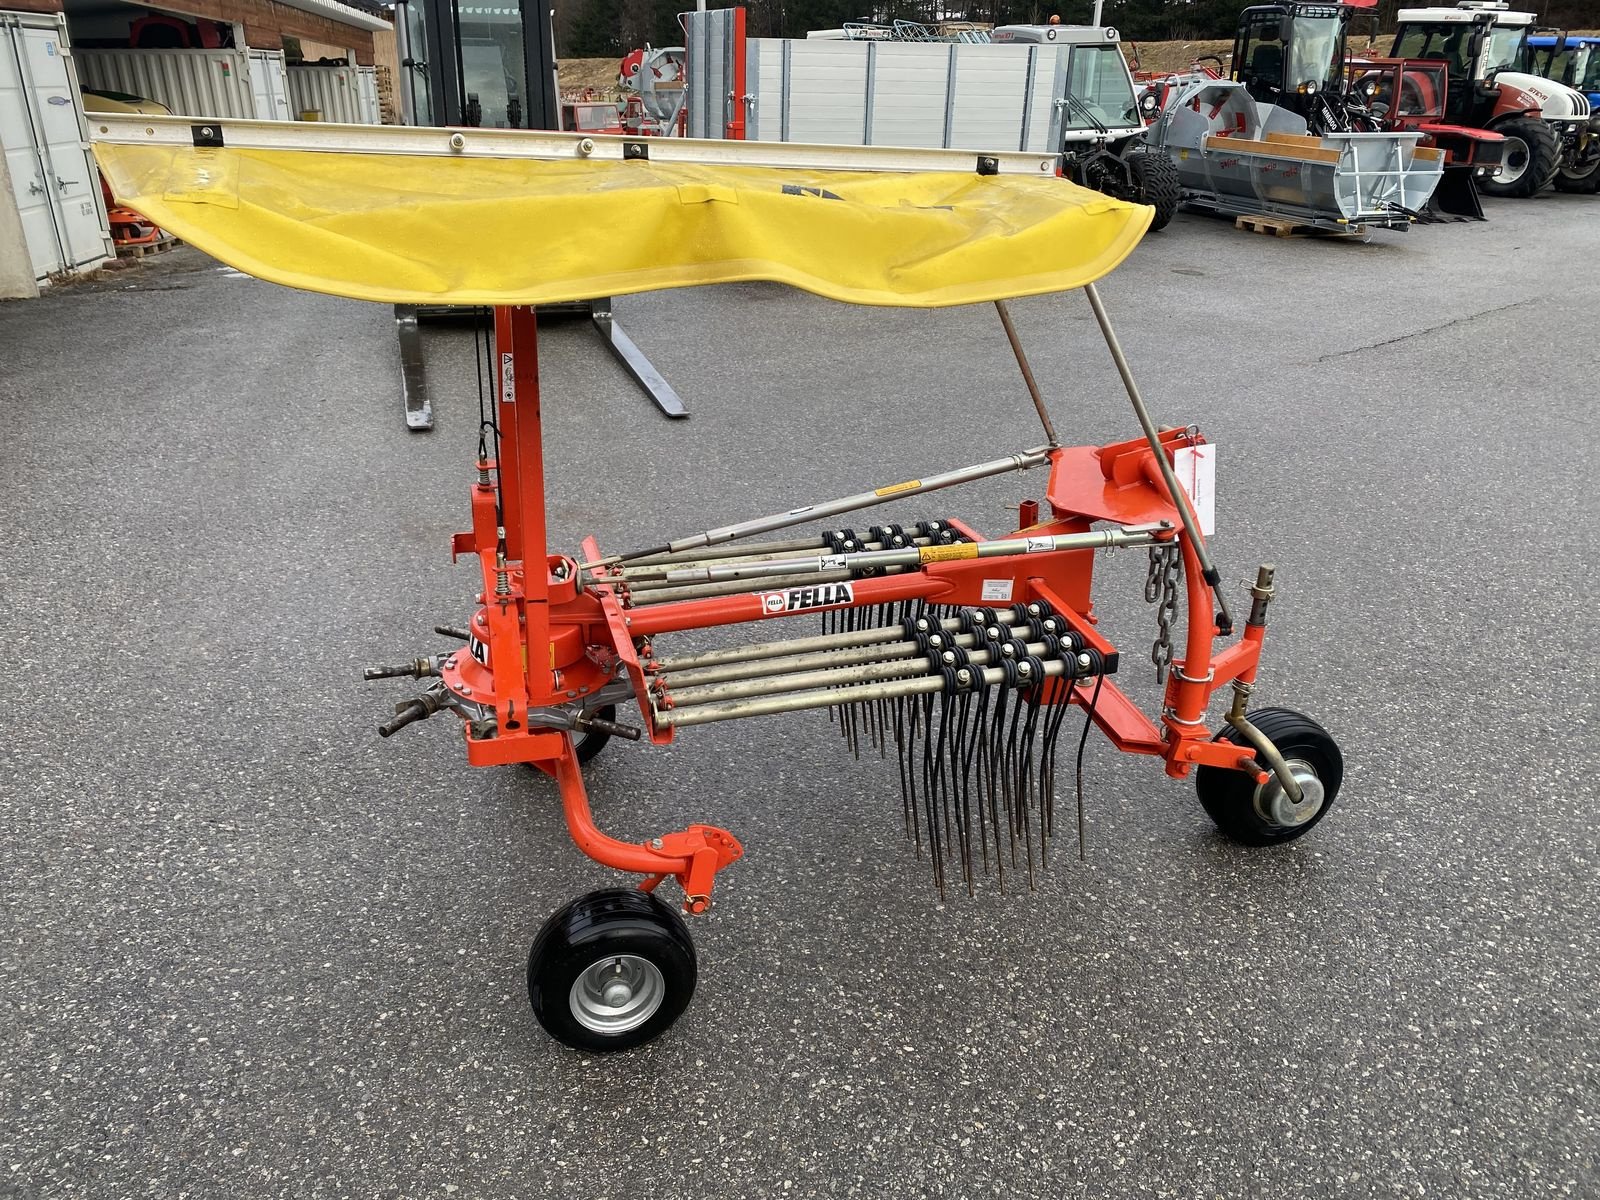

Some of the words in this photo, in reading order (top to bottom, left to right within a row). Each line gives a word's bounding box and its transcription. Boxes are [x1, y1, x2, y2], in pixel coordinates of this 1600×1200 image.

[1528, 87, 1548, 100] STEYR
[1322, 106, 1337, 130] MM800
[767, 598, 783, 606] FELLA
[787, 584, 852, 610] FELLA
